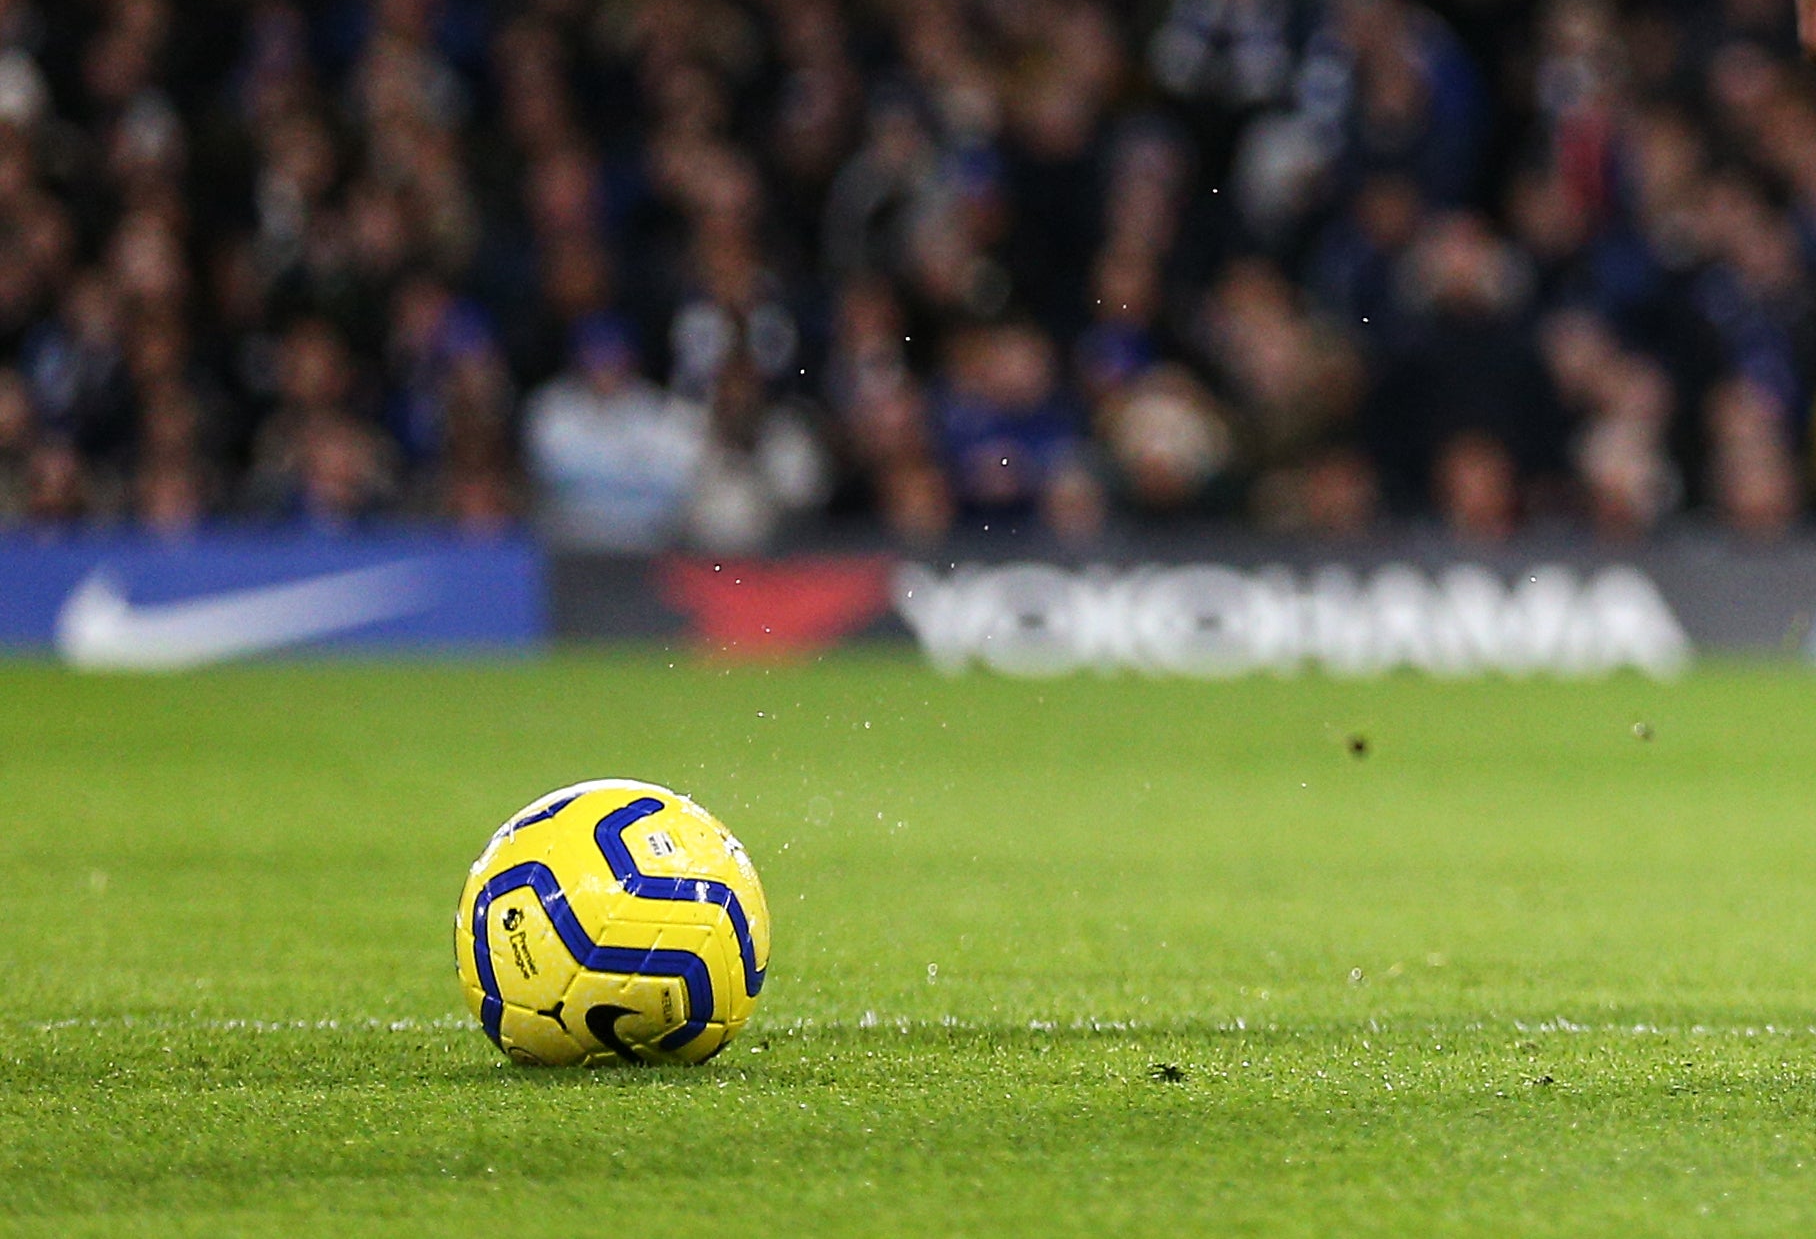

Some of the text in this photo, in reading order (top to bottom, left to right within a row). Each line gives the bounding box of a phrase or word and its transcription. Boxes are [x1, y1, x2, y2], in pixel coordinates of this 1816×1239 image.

[892, 563, 1690, 679] YOKOHAMA
[509, 933, 530, 979] League
[519, 930, 538, 975] Premier
